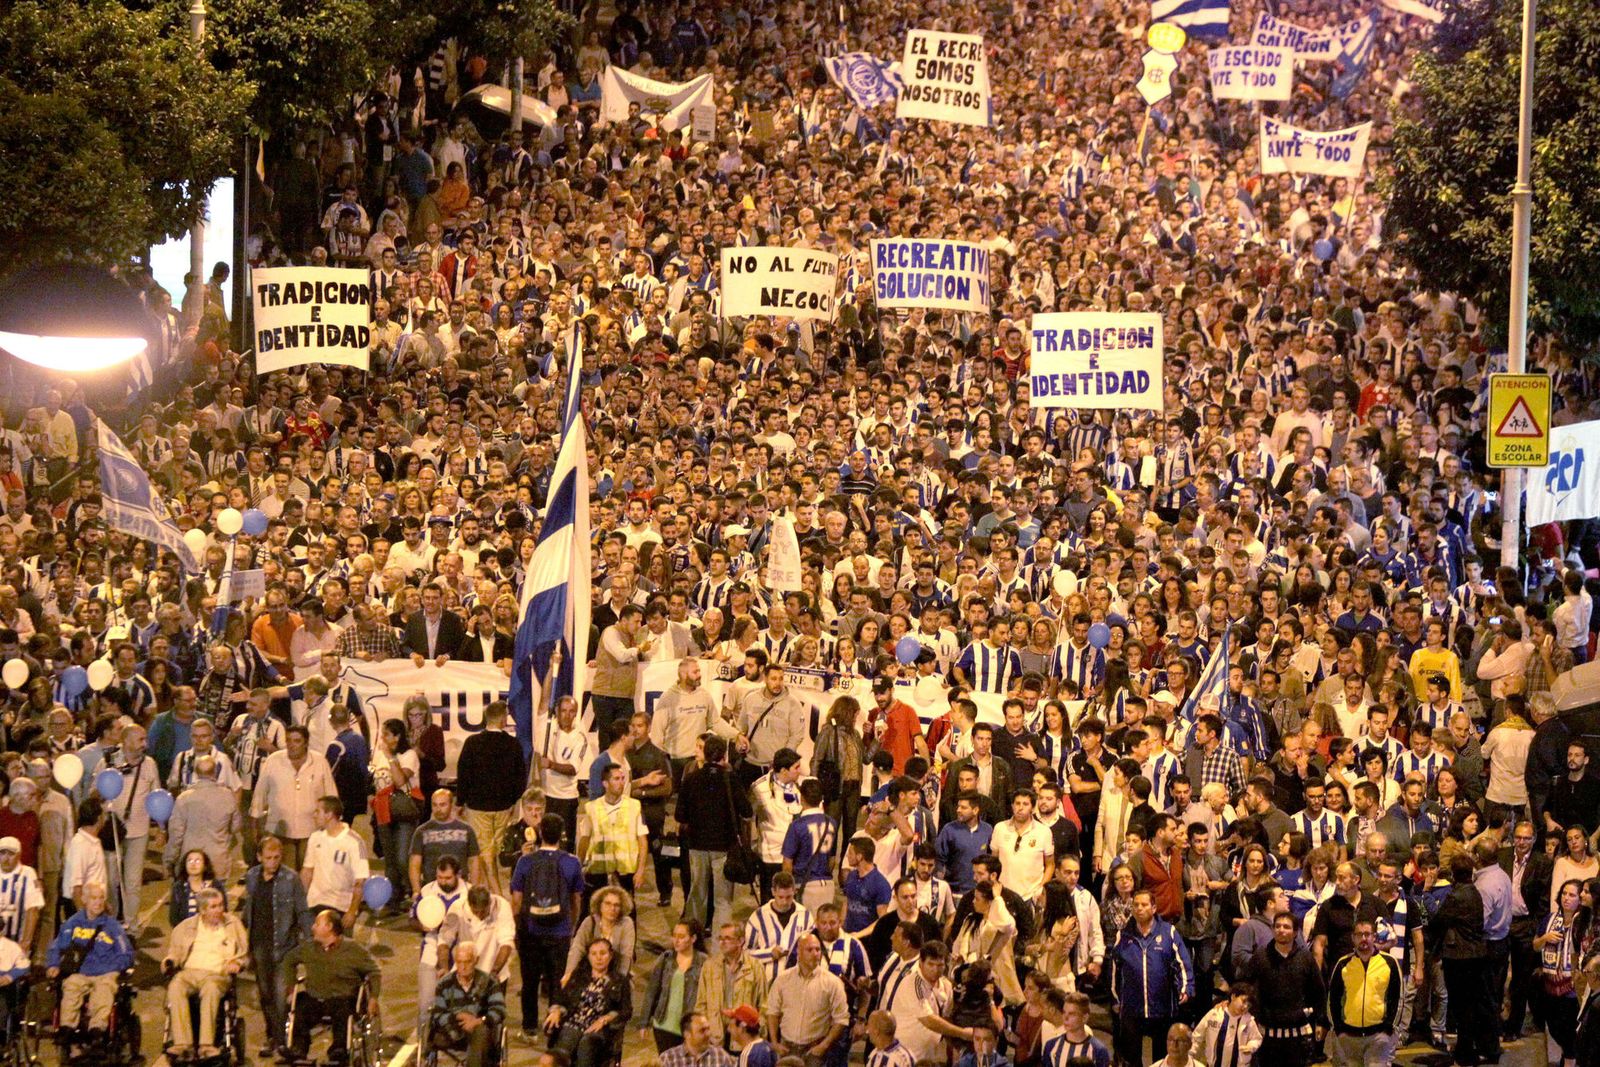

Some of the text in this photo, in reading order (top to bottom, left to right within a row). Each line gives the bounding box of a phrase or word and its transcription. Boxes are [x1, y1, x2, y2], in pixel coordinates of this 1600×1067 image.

[911, 37, 983, 61] EL RECRE
[1224, 50, 1281, 67] ESCUDO
[916, 58, 975, 85] SOMOS
[901, 84, 981, 109] NOSOTROS
[1268, 141, 1350, 162] ANTE TODO
[730, 256, 757, 274] NO
[769, 256, 794, 272] AL
[258, 281, 370, 307] TRADICION
[877, 272, 970, 301] SOLUCION
[311, 305, 321, 322] E
[258, 324, 370, 353] IDENTIDAD
[1032, 327, 1154, 352] TRADICION
[1089, 353, 1099, 369] E
[1032, 370, 1150, 397] IDENTIDAD
[1495, 453, 1542, 461] ESCOLAR
[1505, 444, 1532, 452] ZONA
